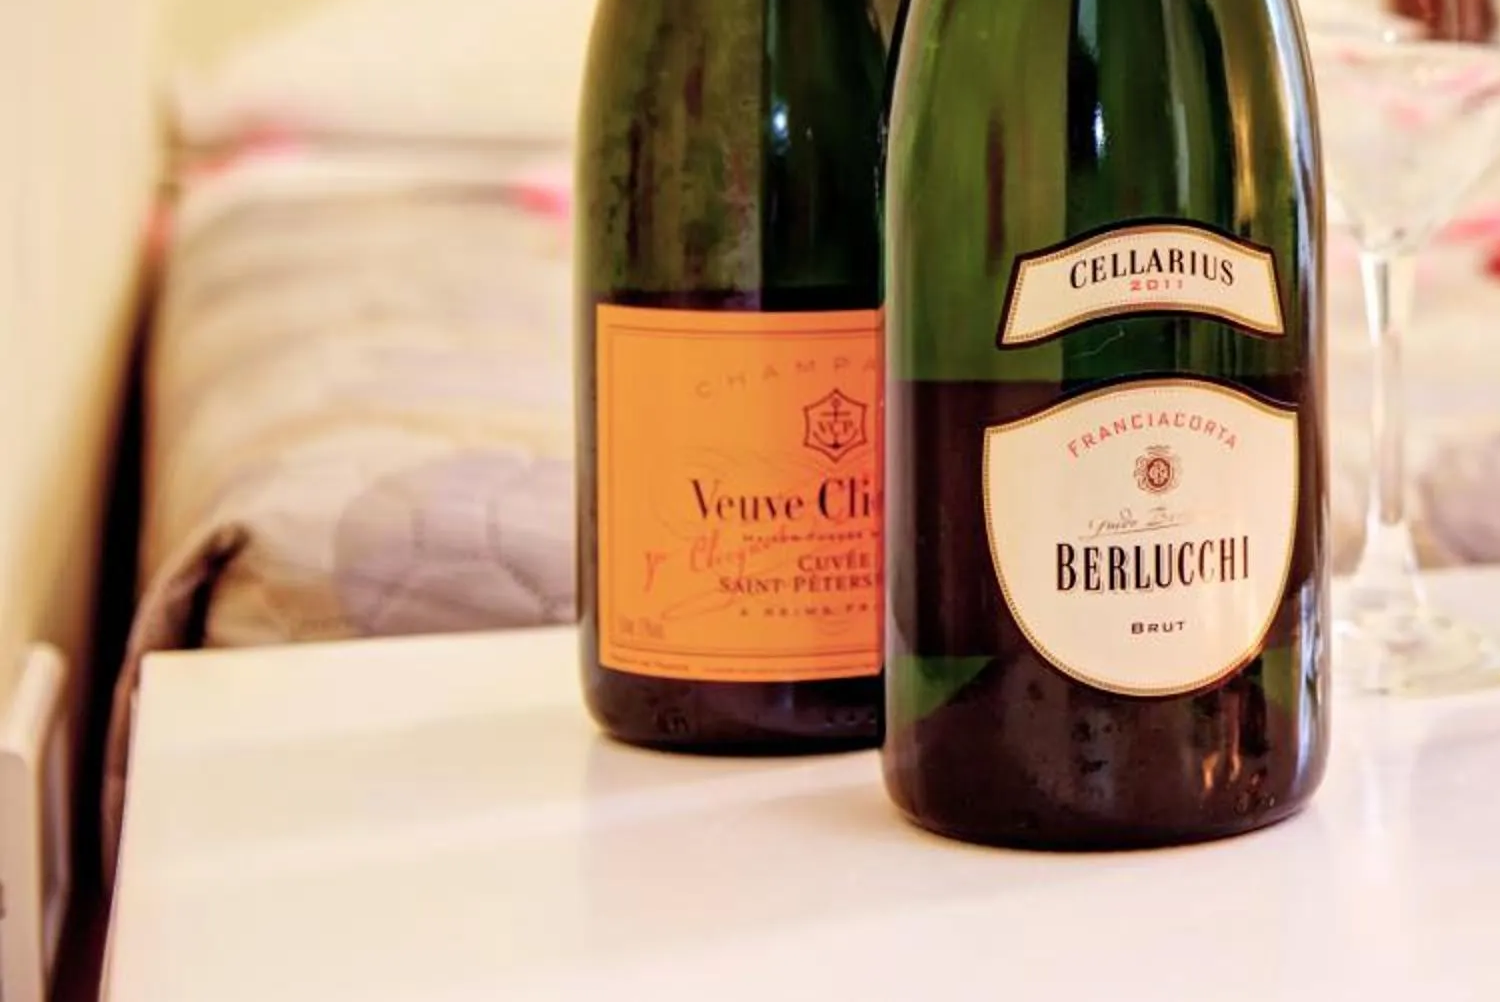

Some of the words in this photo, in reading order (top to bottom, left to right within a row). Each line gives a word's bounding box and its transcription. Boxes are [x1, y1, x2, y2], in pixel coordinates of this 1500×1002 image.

[1069, 248, 1236, 290] CELLARIUS
[1129, 279, 1185, 293] 2011
[1066, 411, 1239, 459] FRANCIACORTA
[690, 478, 804, 521] Veuve
[1055, 535, 1250, 594] BERLUCCHI
[1130, 619, 1186, 636] BRUT
